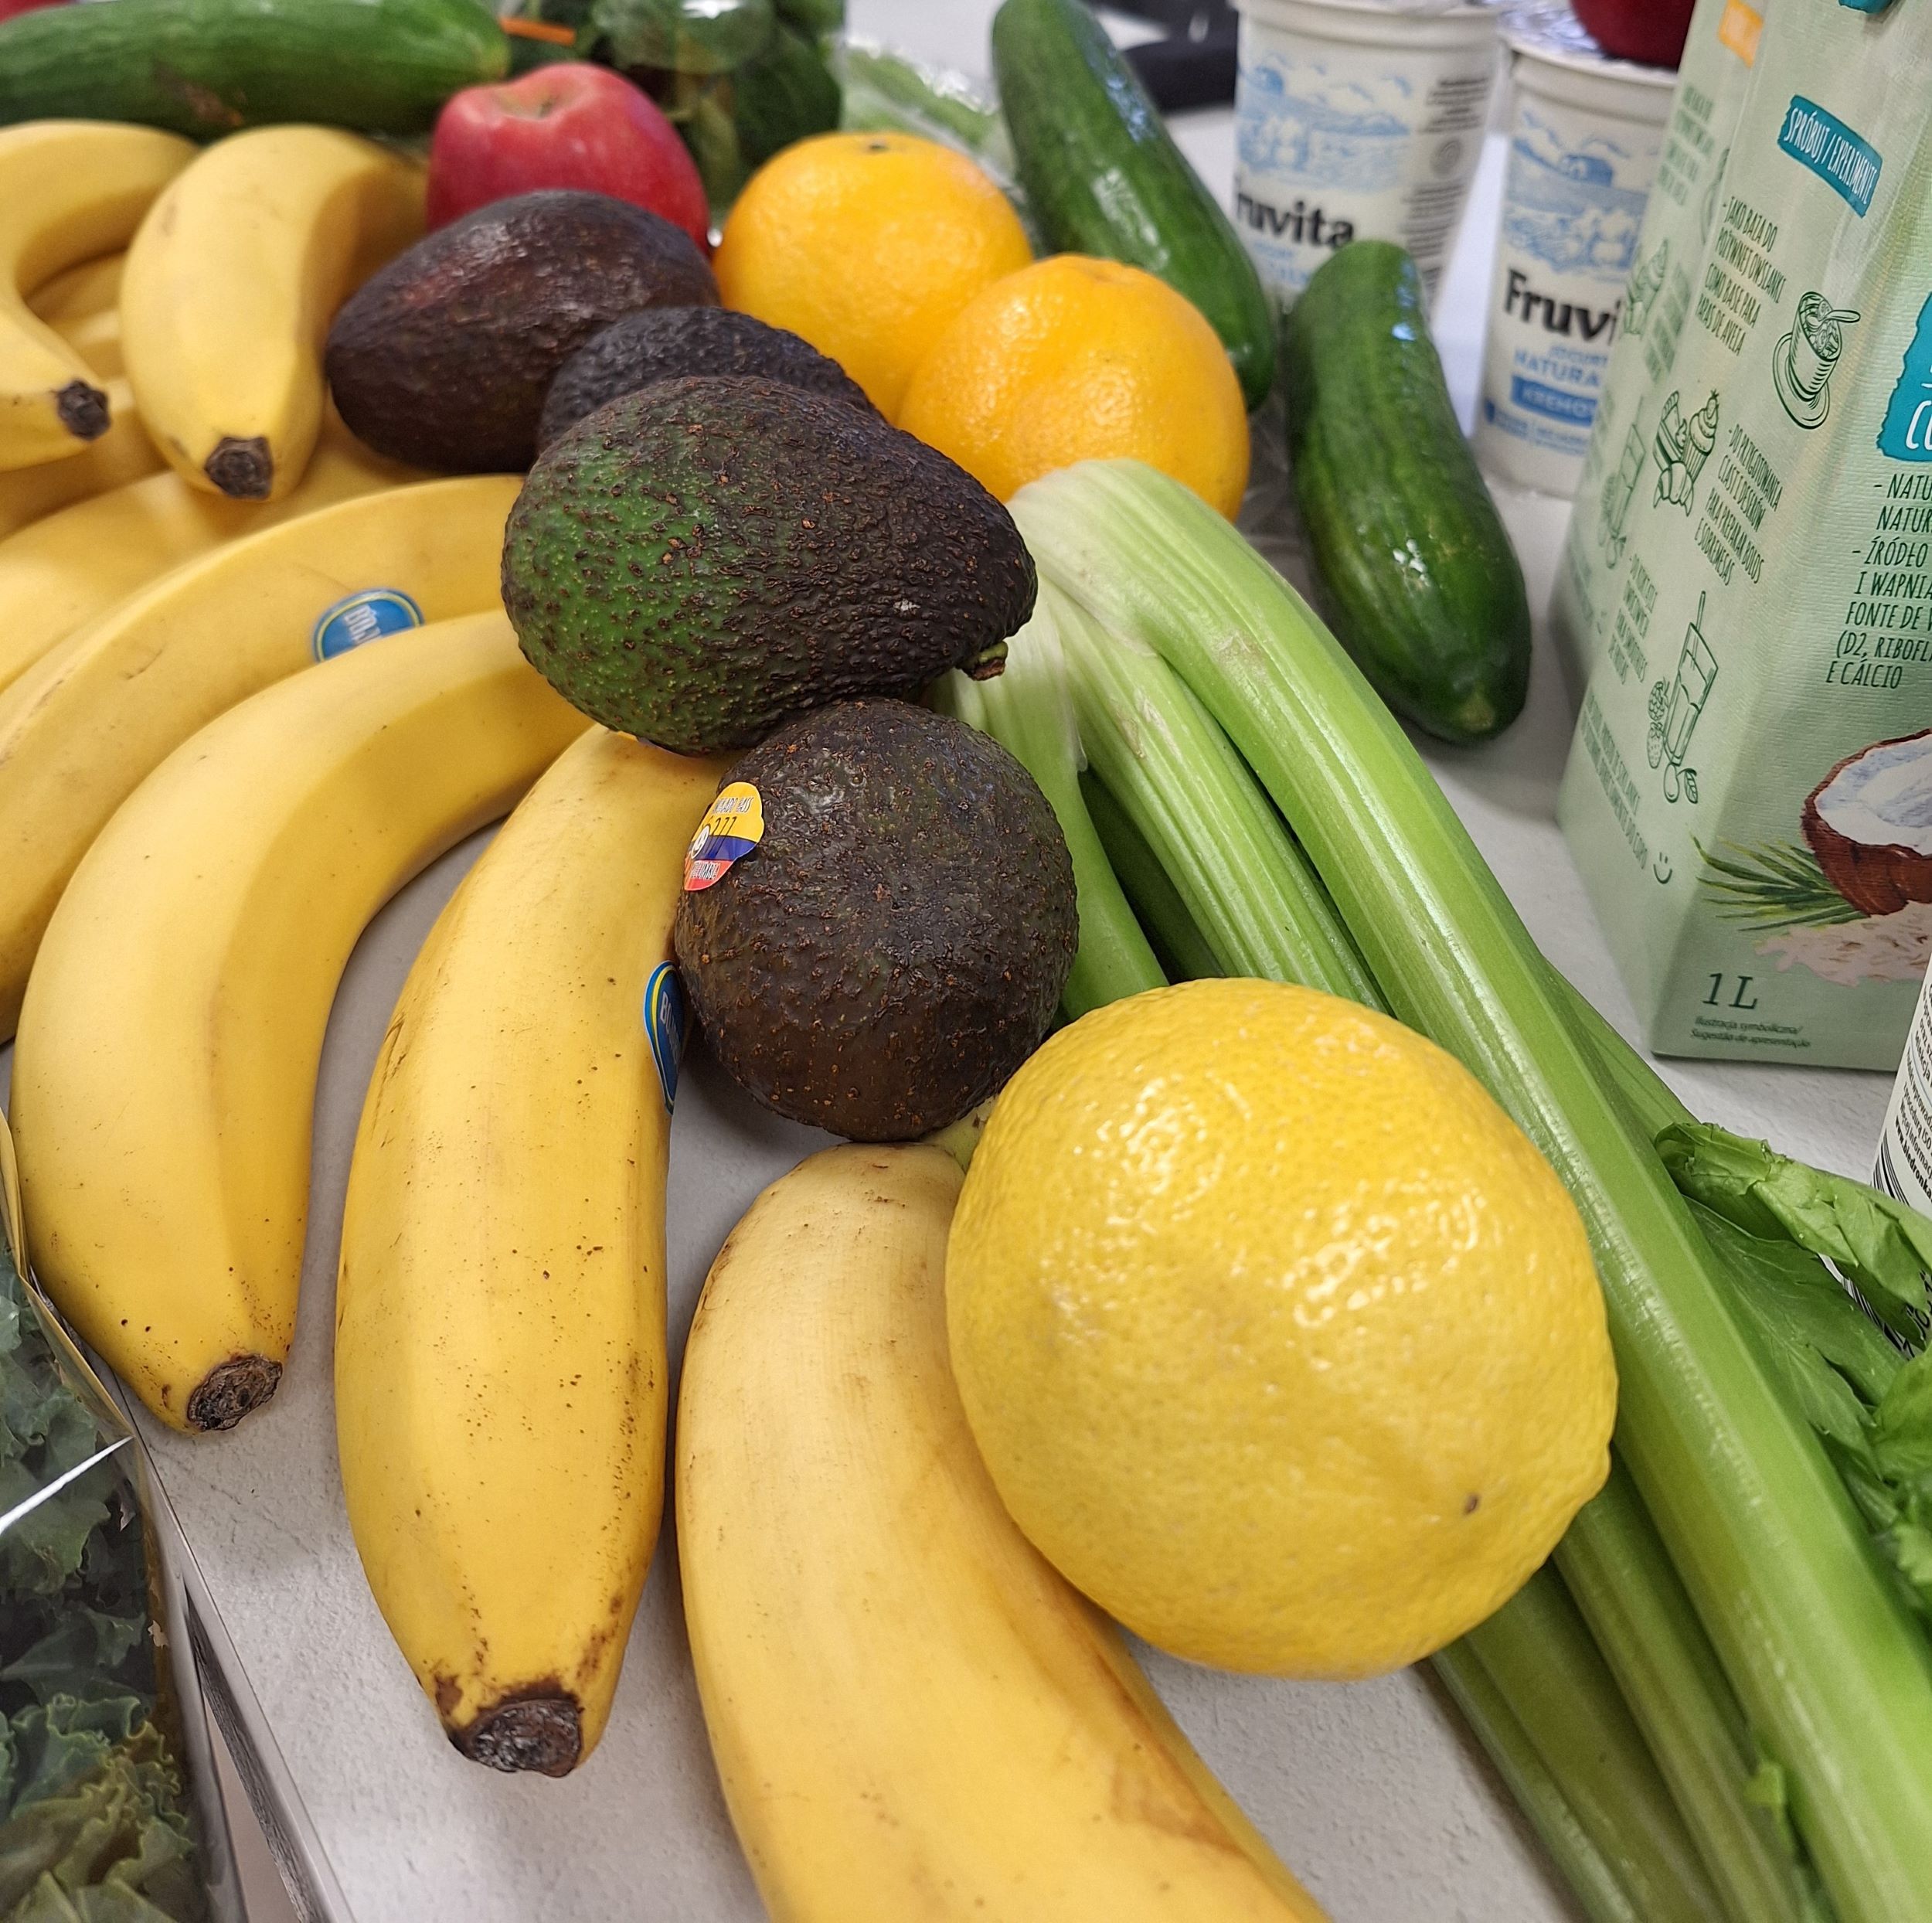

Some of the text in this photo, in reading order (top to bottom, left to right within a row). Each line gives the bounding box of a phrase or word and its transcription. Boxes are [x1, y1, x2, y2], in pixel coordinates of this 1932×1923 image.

[1784, 107, 1830, 163] SPRÓBUJ
[1827, 136, 1877, 205] EXPERIMENTE
[1724, 196, 1747, 230] JAKO
[1743, 209, 1767, 244] BAZA
[1762, 222, 1777, 253] DO
[1722, 278, 1743, 314] BASE
[1739, 291, 1761, 328] PARA
[1712, 309, 1725, 338] DE
[1729, 424, 1743, 454] DO
[1718, 454, 1740, 495] CIAST
[1876, 505, 1932, 533] NATUR
[1705, 487, 1723, 526] PARA
[1741, 541, 1764, 584] BOLOS
[1864, 536, 1929, 568] ŹRÓDŁO
[1854, 571, 1868, 594] I
[1845, 601, 1899, 628] FONTE
[1900, 606, 1923, 630] DE
[1836, 630, 1868, 659] (D2,
[1825, 659, 1903, 689] E CÁLCIO
